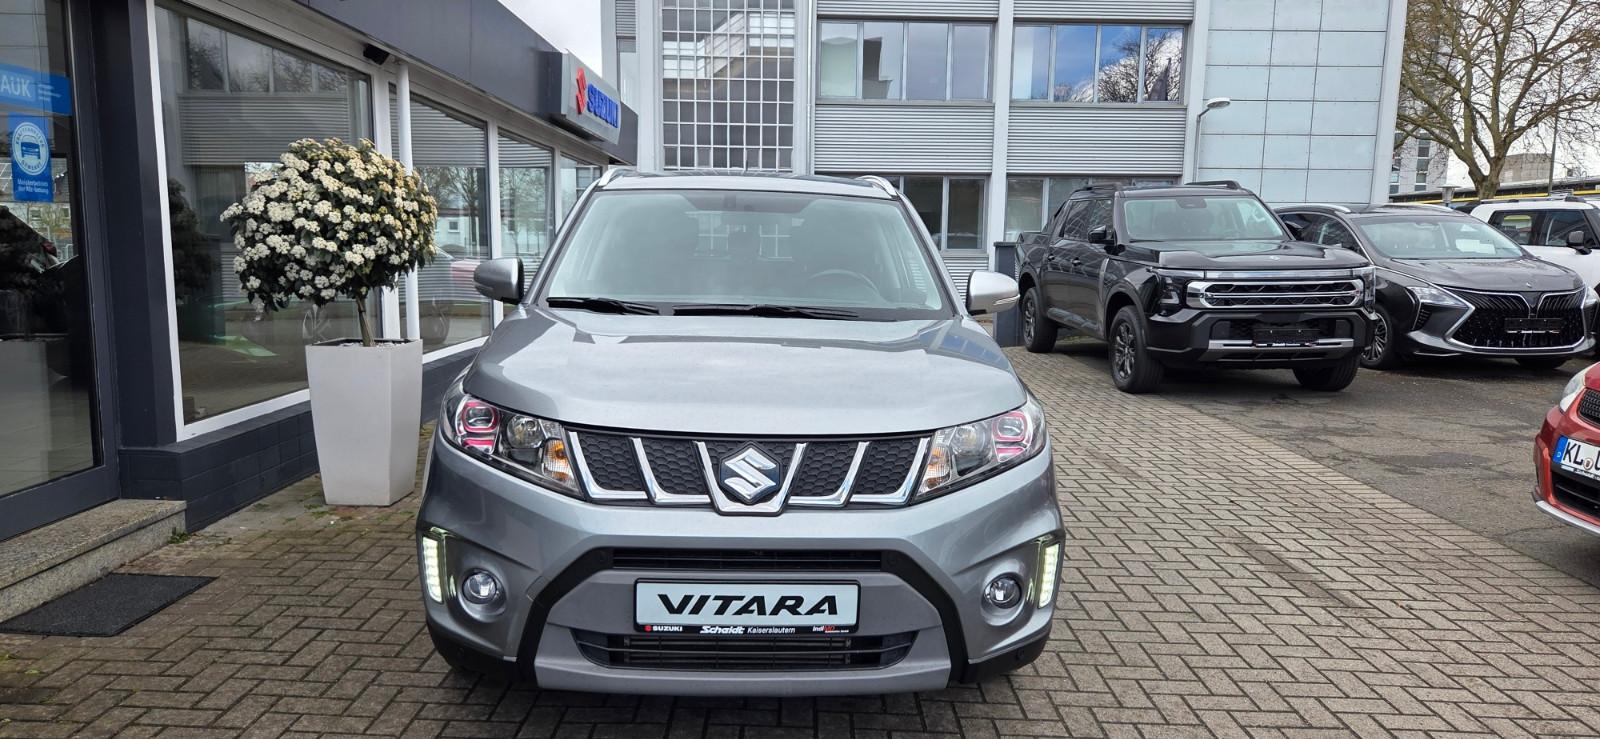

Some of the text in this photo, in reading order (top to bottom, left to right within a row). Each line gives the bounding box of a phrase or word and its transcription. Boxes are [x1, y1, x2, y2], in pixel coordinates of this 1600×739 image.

[587, 83, 618, 129] SUZUKI
[1563, 441, 1584, 466] KL
[657, 593, 838, 616] VITARA
[700, 625, 796, 634] Schaidt Kaiserslautern
